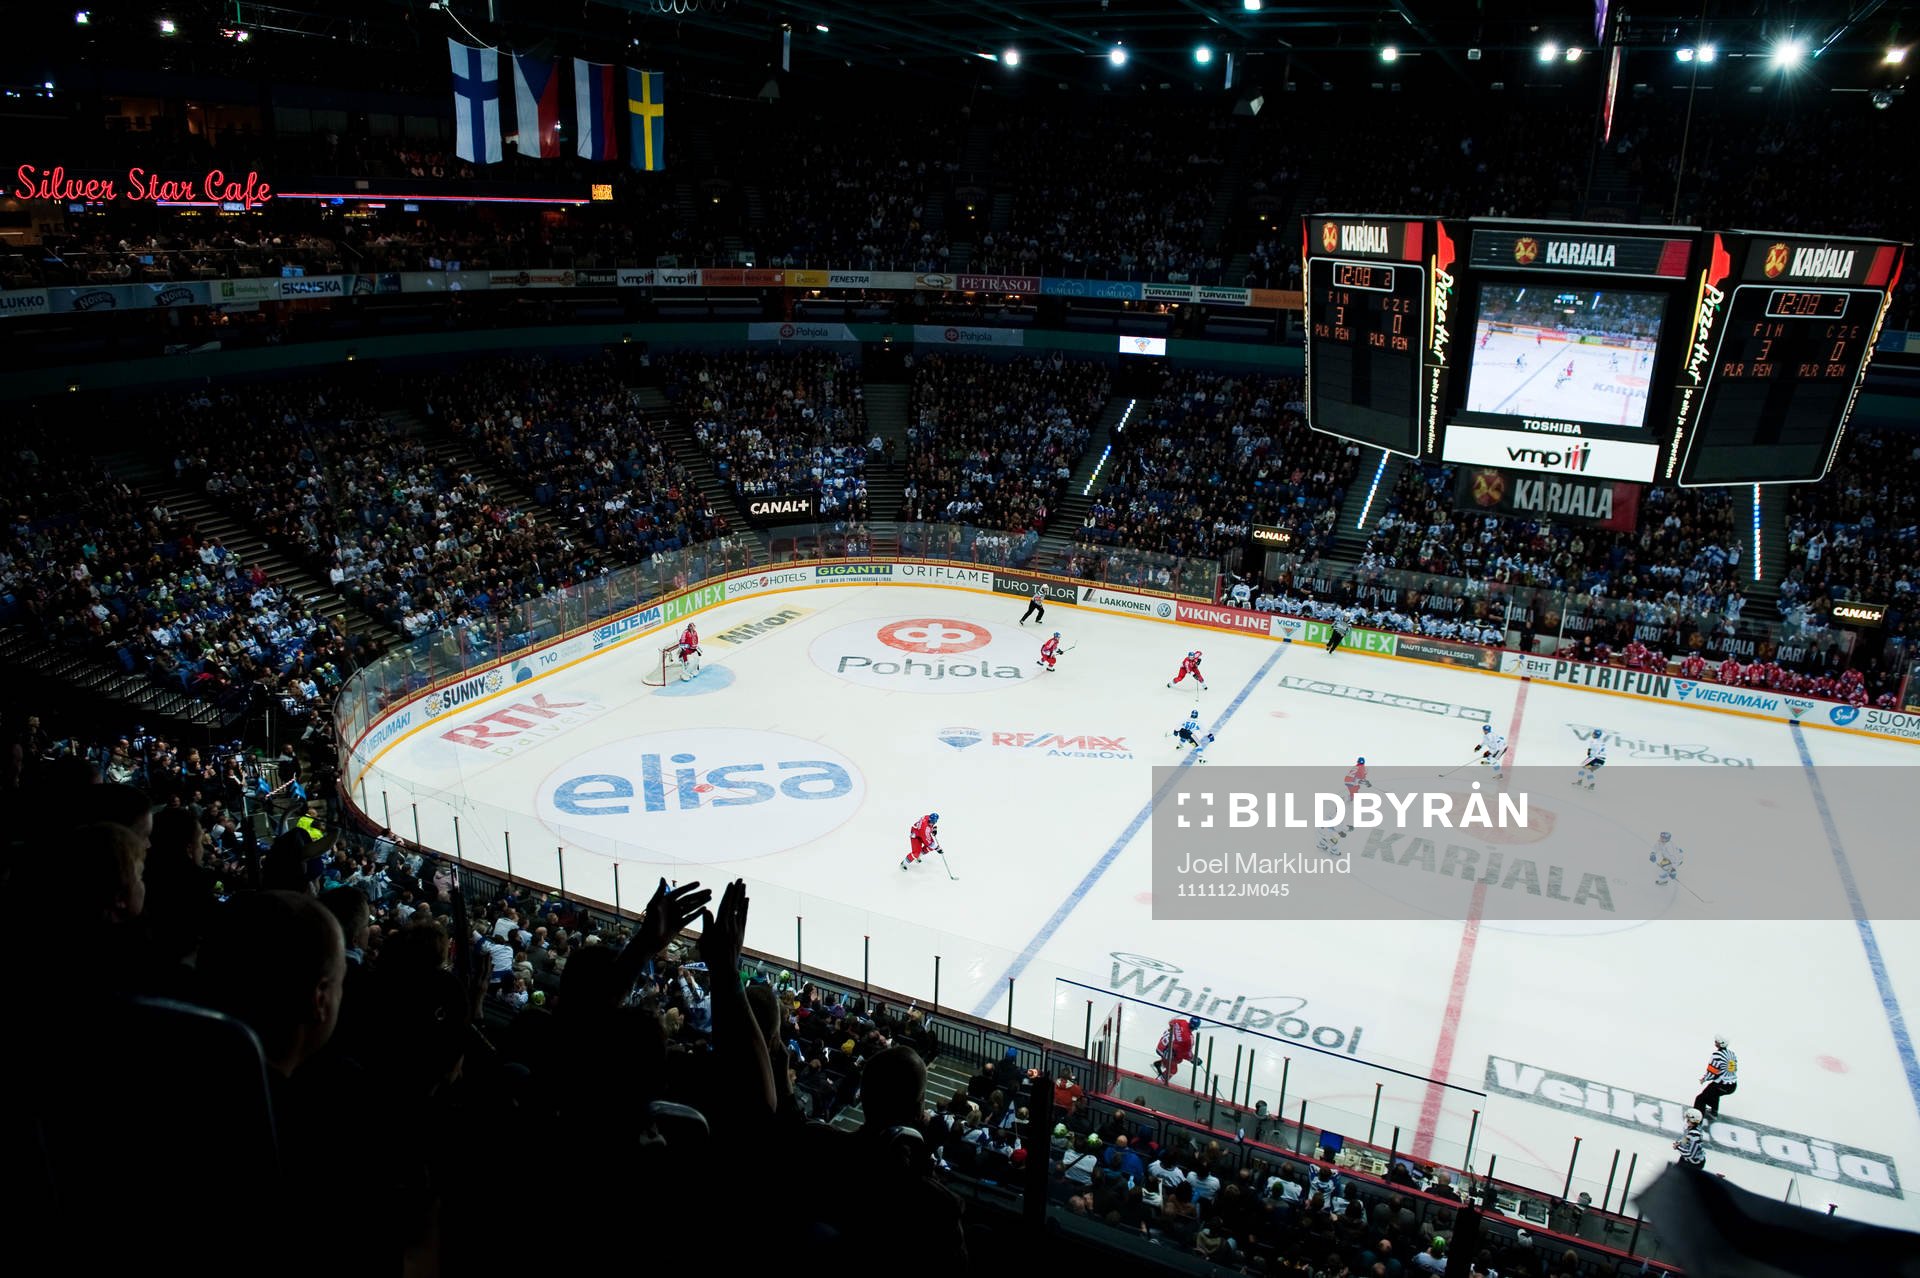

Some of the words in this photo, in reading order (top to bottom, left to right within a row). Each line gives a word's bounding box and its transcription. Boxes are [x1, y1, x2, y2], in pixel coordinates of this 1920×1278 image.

[15, 164, 118, 201] Silver
[127, 167, 197, 201] Star
[204, 170, 273, 211] Cafe
[1545, 241, 1616, 268] KARJALA
[1789, 246, 1856, 279] KARJALA
[830, 275, 870, 283] FENESTRA
[960, 277, 1035, 293] PETRASOL
[1341, 265, 1371, 287] 12:08
[282, 281, 342, 296] SKANSKA
[1143, 288, 1193, 298] TURVATIIMI
[1198, 291, 1249, 300] TURVATIIMI
[1435, 267, 1454, 323] Pizza
[1698, 283, 1725, 341] Pizza
[1776, 293, 1821, 315] 12:08
[795, 327, 829, 338] Pohjola
[960, 332, 992, 343] Pohjola
[1433, 324, 1450, 365] Hut
[1688, 342, 1711, 386] Hut
[1522, 420, 1582, 435] TOSHIBA
[1506, 446, 1561, 468] vmp
[750, 499, 810, 515] CANAL+
[1512, 479, 1614, 520] KARJALA
[1253, 530, 1291, 542] CANAL+
[728, 581, 759, 594] SOKOS
[768, 572, 807, 586] HOTELS
[902, 565, 990, 583] ORIFLAME
[995, 578, 1029, 593] TURO
[666, 585, 723, 618] PLANEX
[1100, 596, 1151, 612] LAAKKONEN
[600, 607, 660, 640] BILTEMA
[1177, 606, 1231, 625] VIKING
[1235, 613, 1270, 631] LINE
[1277, 618, 1301, 628] VICKS
[1833, 606, 1882, 621] CANAL+
[717, 609, 803, 645] Nikon
[539, 651, 558, 668] TVO
[837, 655, 1024, 680] Pohjola
[1527, 660, 1552, 673] EHT
[1553, 660, 1671, 698] PETRIFUN
[443, 676, 486, 709] SUNNY
[1695, 686, 1779, 711] VIERUMÄKI
[1784, 698, 1815, 708] VICKS
[440, 693, 589, 749] RTK
[991, 732, 1132, 752] RE/MAX
[553, 753, 853, 816] elisa
[1360, 828, 1616, 913] KARJALA
[1109, 957, 1363, 1056] Whirlpool
